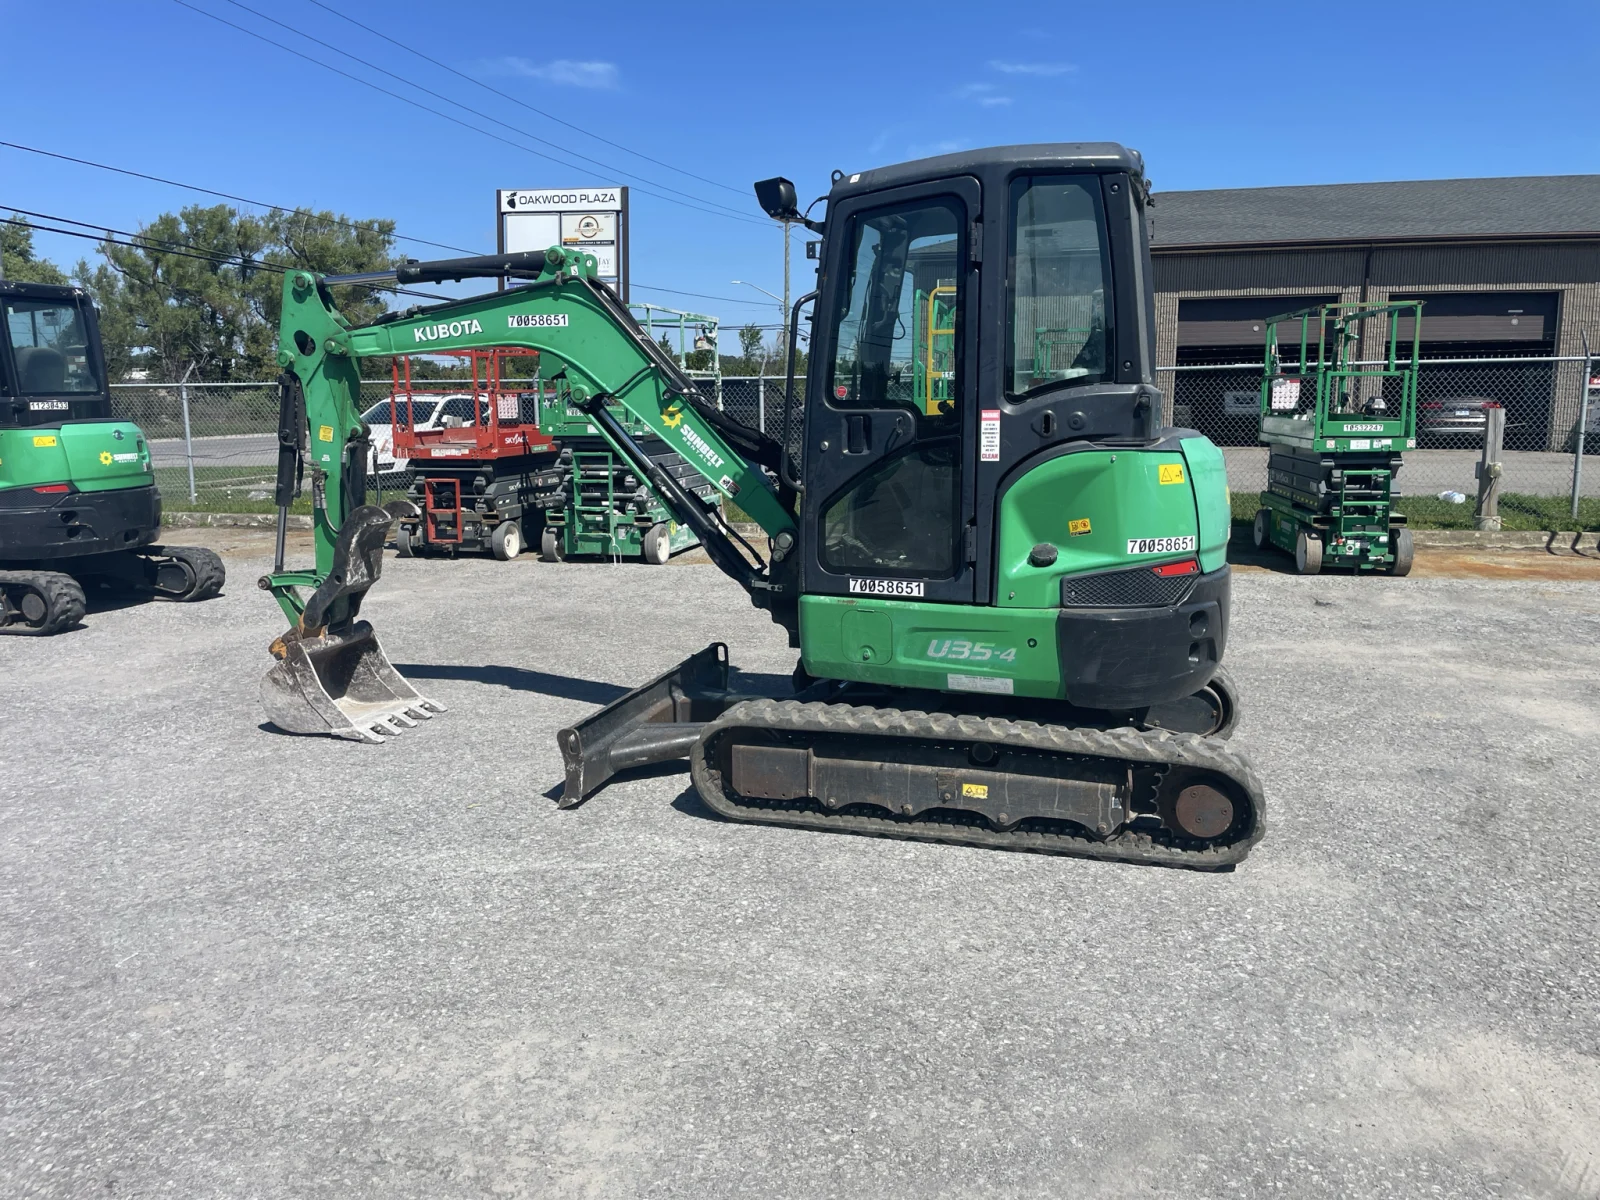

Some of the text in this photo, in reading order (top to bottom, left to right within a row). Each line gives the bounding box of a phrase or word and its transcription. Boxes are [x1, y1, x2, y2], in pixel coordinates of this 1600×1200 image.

[519, 193, 616, 205] OAKWOOD PLAZA
[413, 319, 483, 342] KUBOTA
[510, 314, 566, 327] 70058651
[680, 423, 725, 468] SUNBELT
[682, 436, 712, 467] RENTALS
[1129, 536, 1194, 553] 70058651
[851, 579, 924, 596] 70058651
[926, 639, 1017, 662] U35-4
